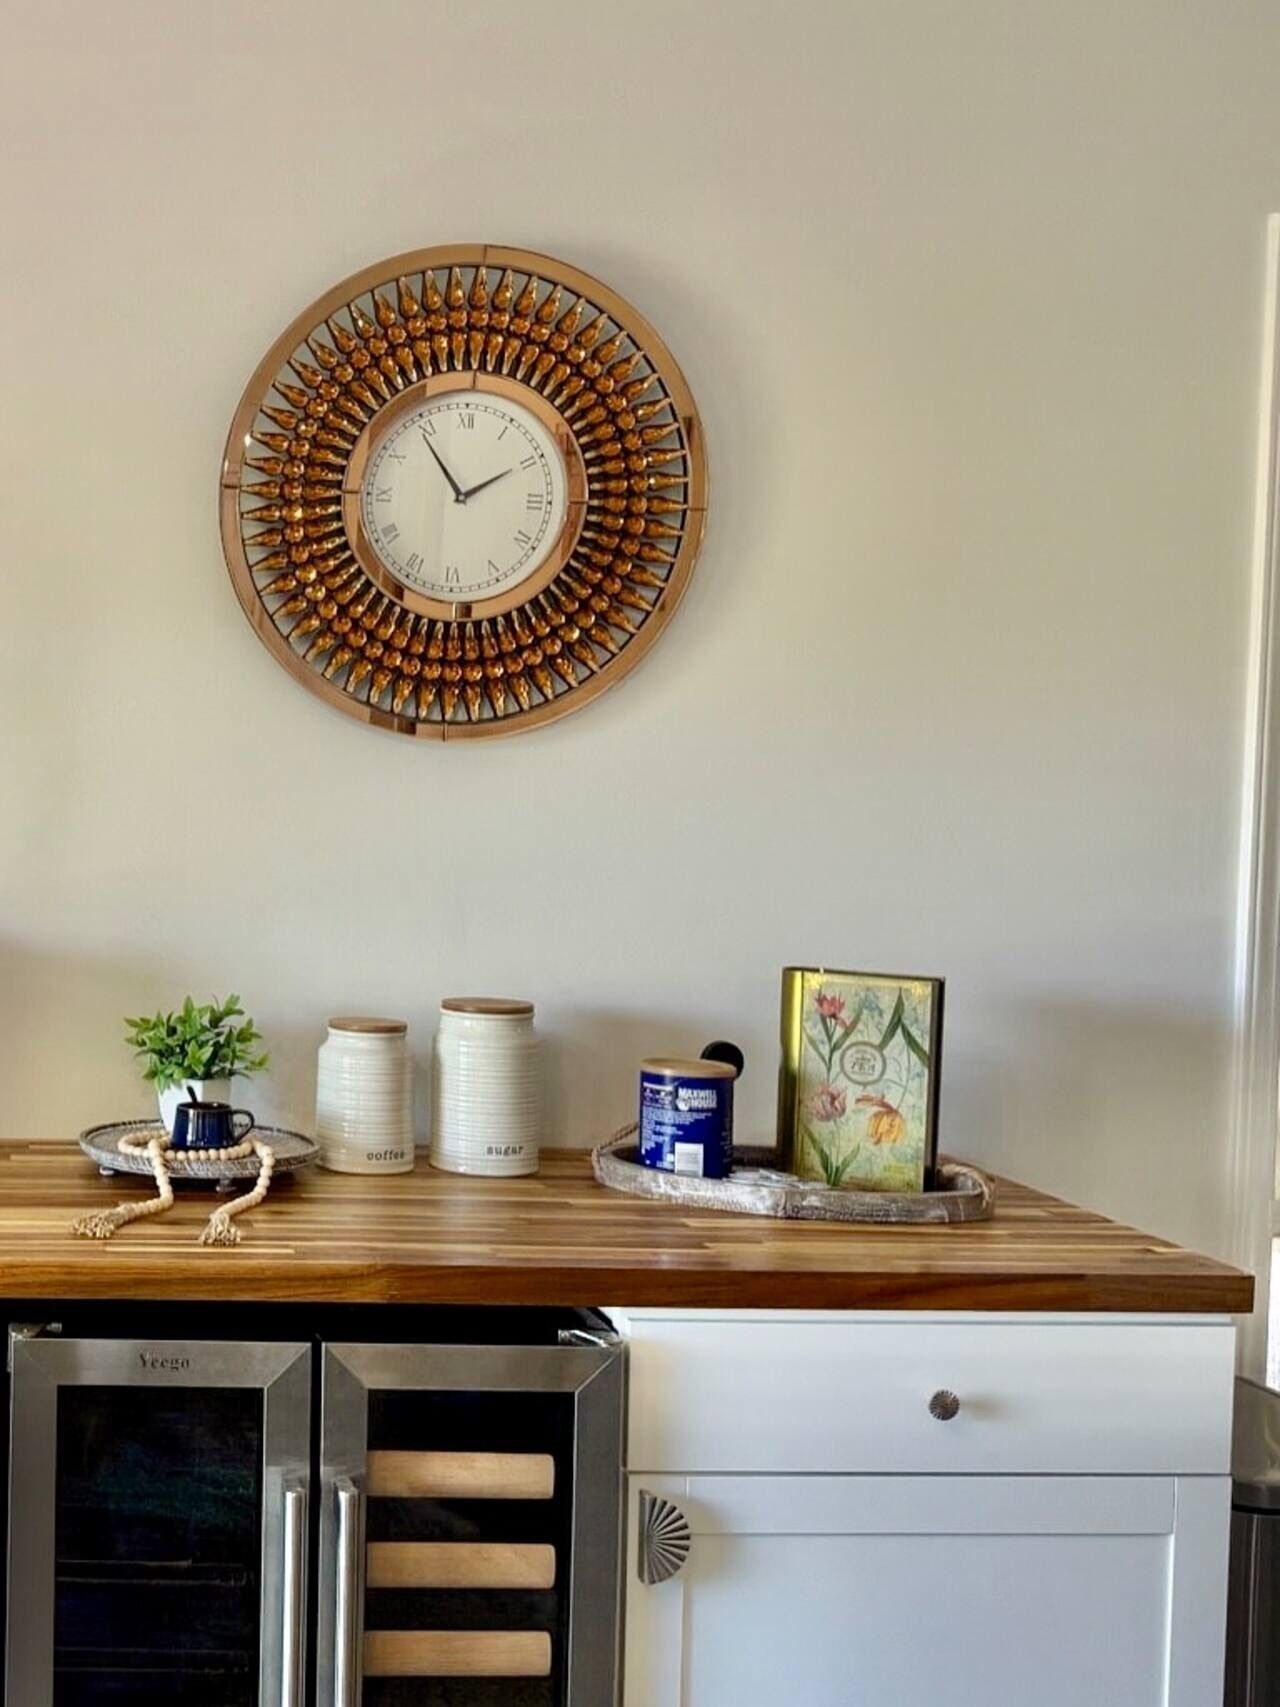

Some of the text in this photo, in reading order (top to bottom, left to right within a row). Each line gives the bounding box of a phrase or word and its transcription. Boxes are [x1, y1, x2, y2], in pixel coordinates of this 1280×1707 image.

[457, 412, 475, 430] XII
[389, 448, 407, 465] X
[520, 455, 538, 470] II
[526, 493, 544, 511] III
[366, 1149, 406, 1162] coffee
[485, 1144, 524, 1157] sugar
